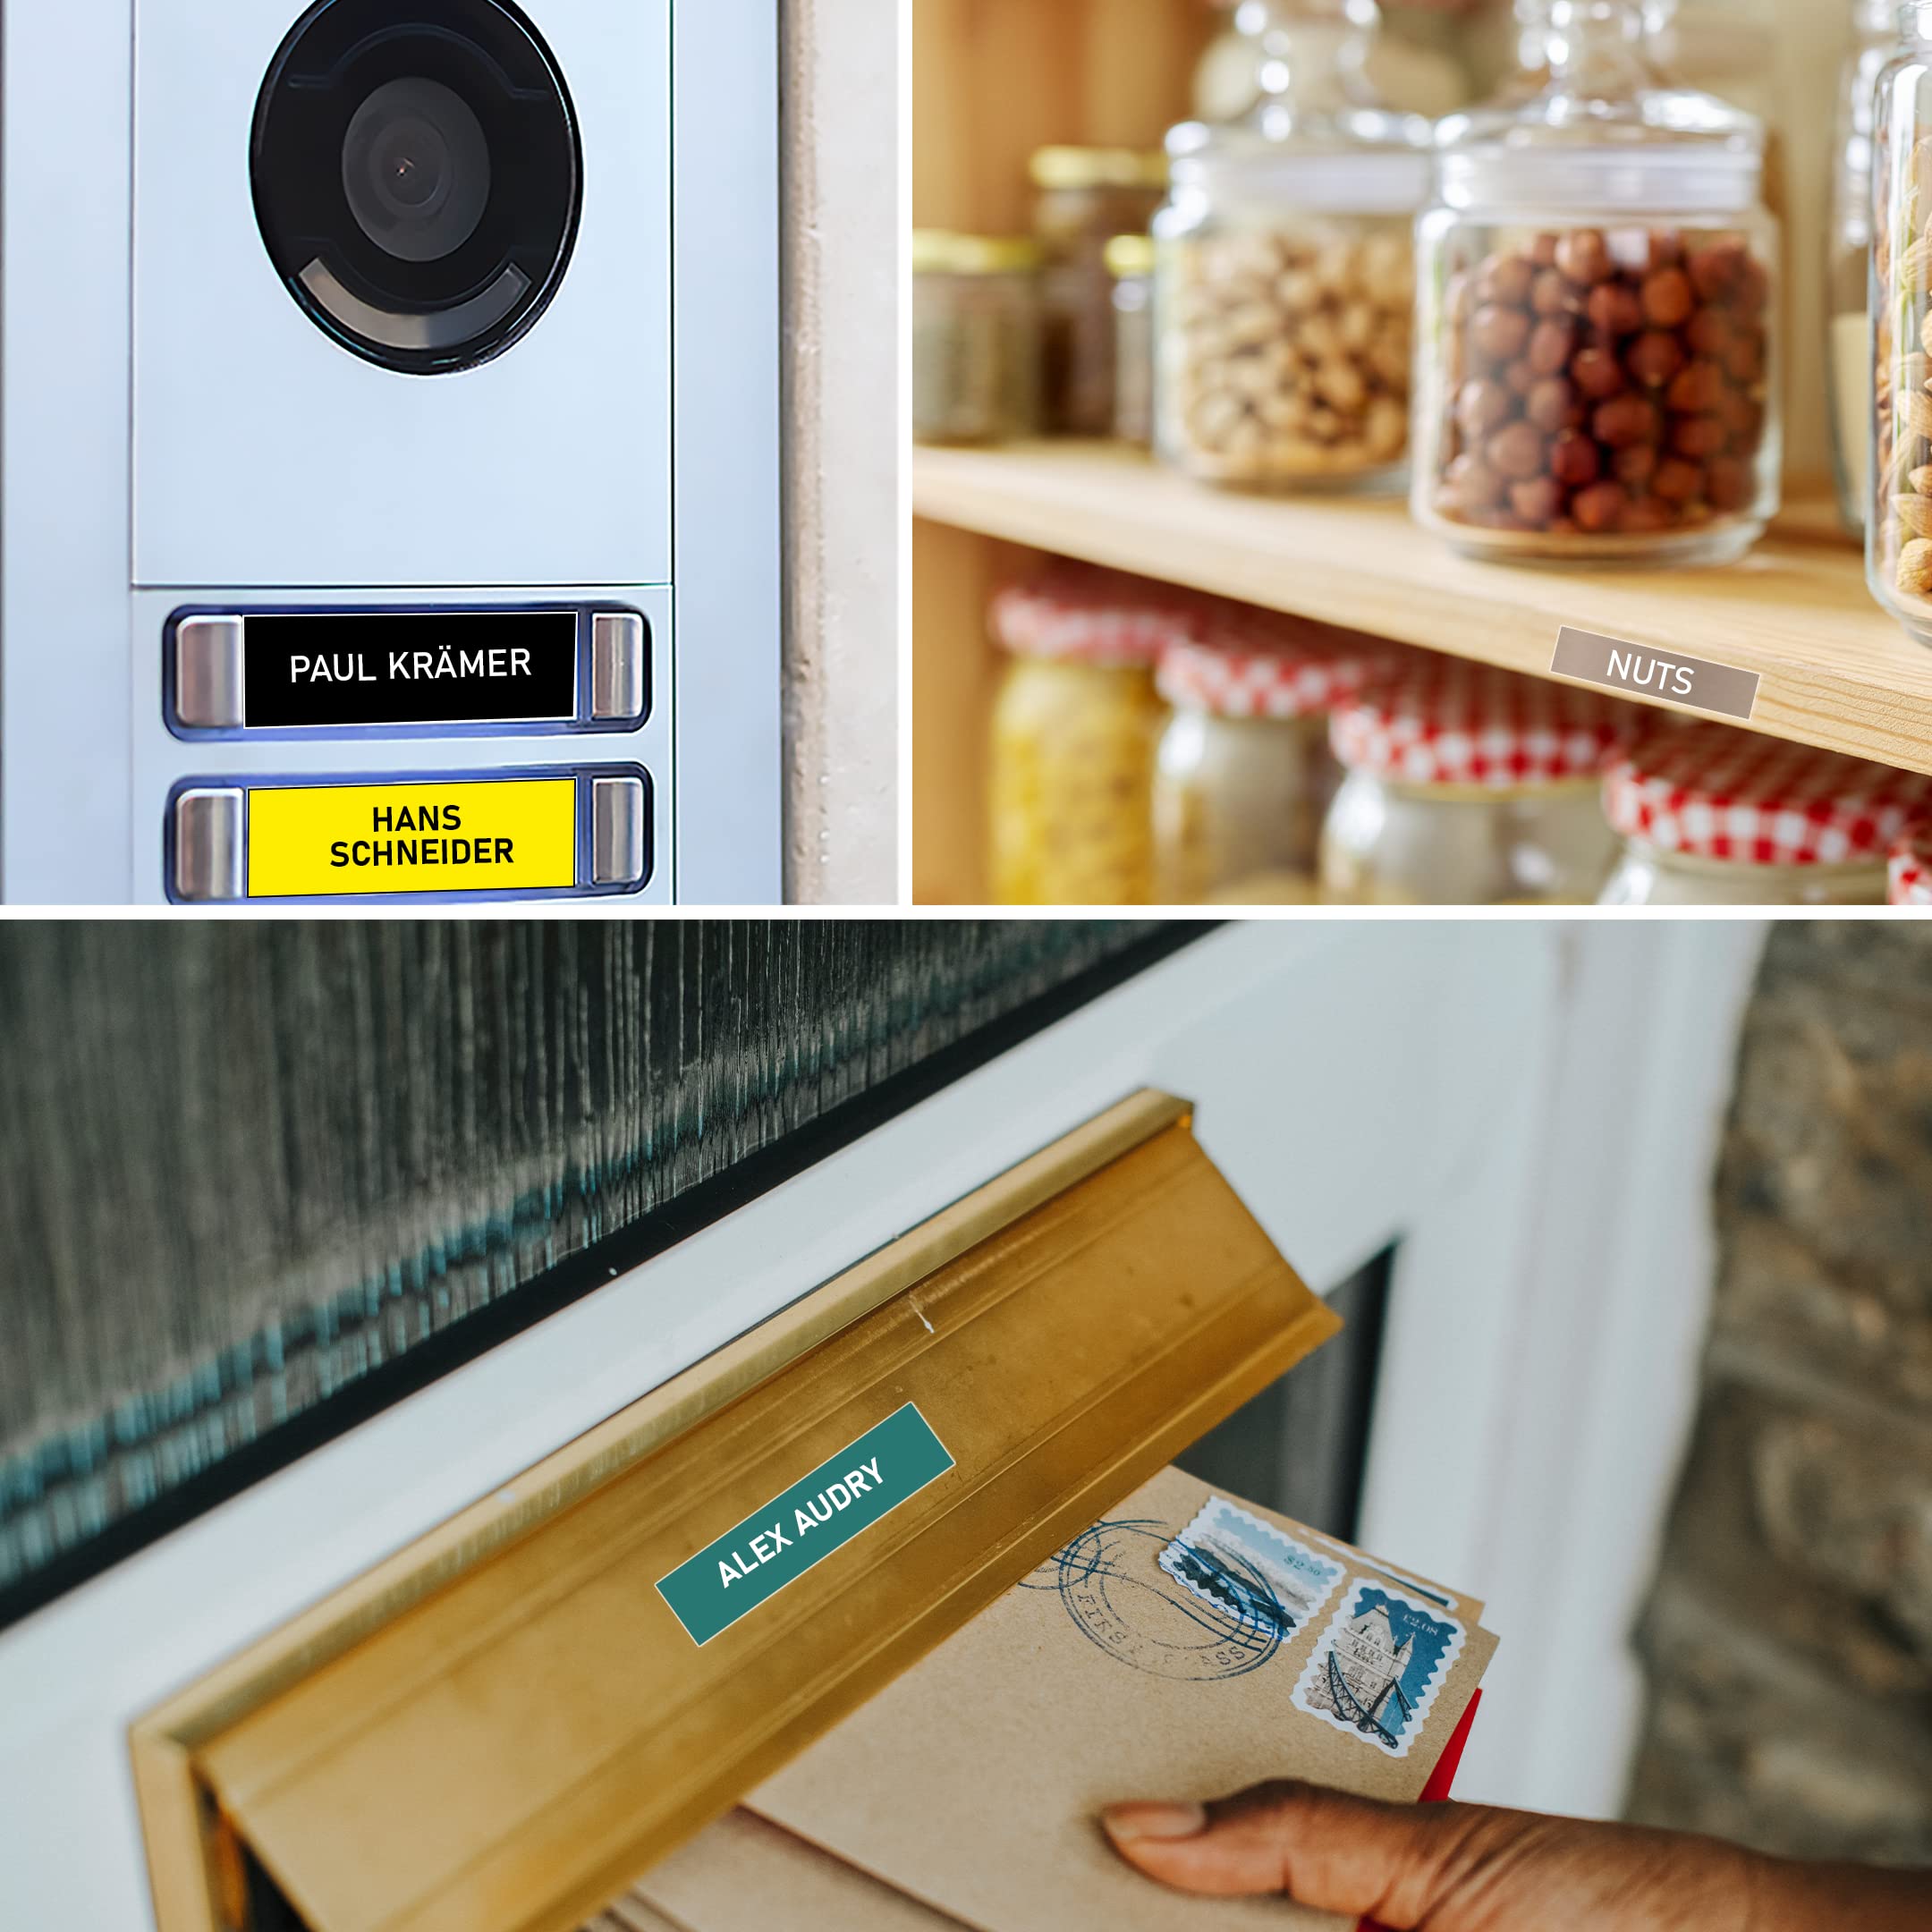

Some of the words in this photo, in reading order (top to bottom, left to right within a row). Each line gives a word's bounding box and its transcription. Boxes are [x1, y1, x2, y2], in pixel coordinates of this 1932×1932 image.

[290, 654, 377, 683] PAUL
[389, 645, 532, 680] KRÄMER
[1606, 649, 1695, 695] NUTS
[373, 805, 462, 833] HANS
[330, 838, 514, 868] SCHNEIDER
[718, 1522, 793, 1589] ALEX
[794, 1456, 884, 1537] AUDRY
[1077, 1594, 1144, 1655] FIRS
[1163, 1645, 1245, 1666] CASS
